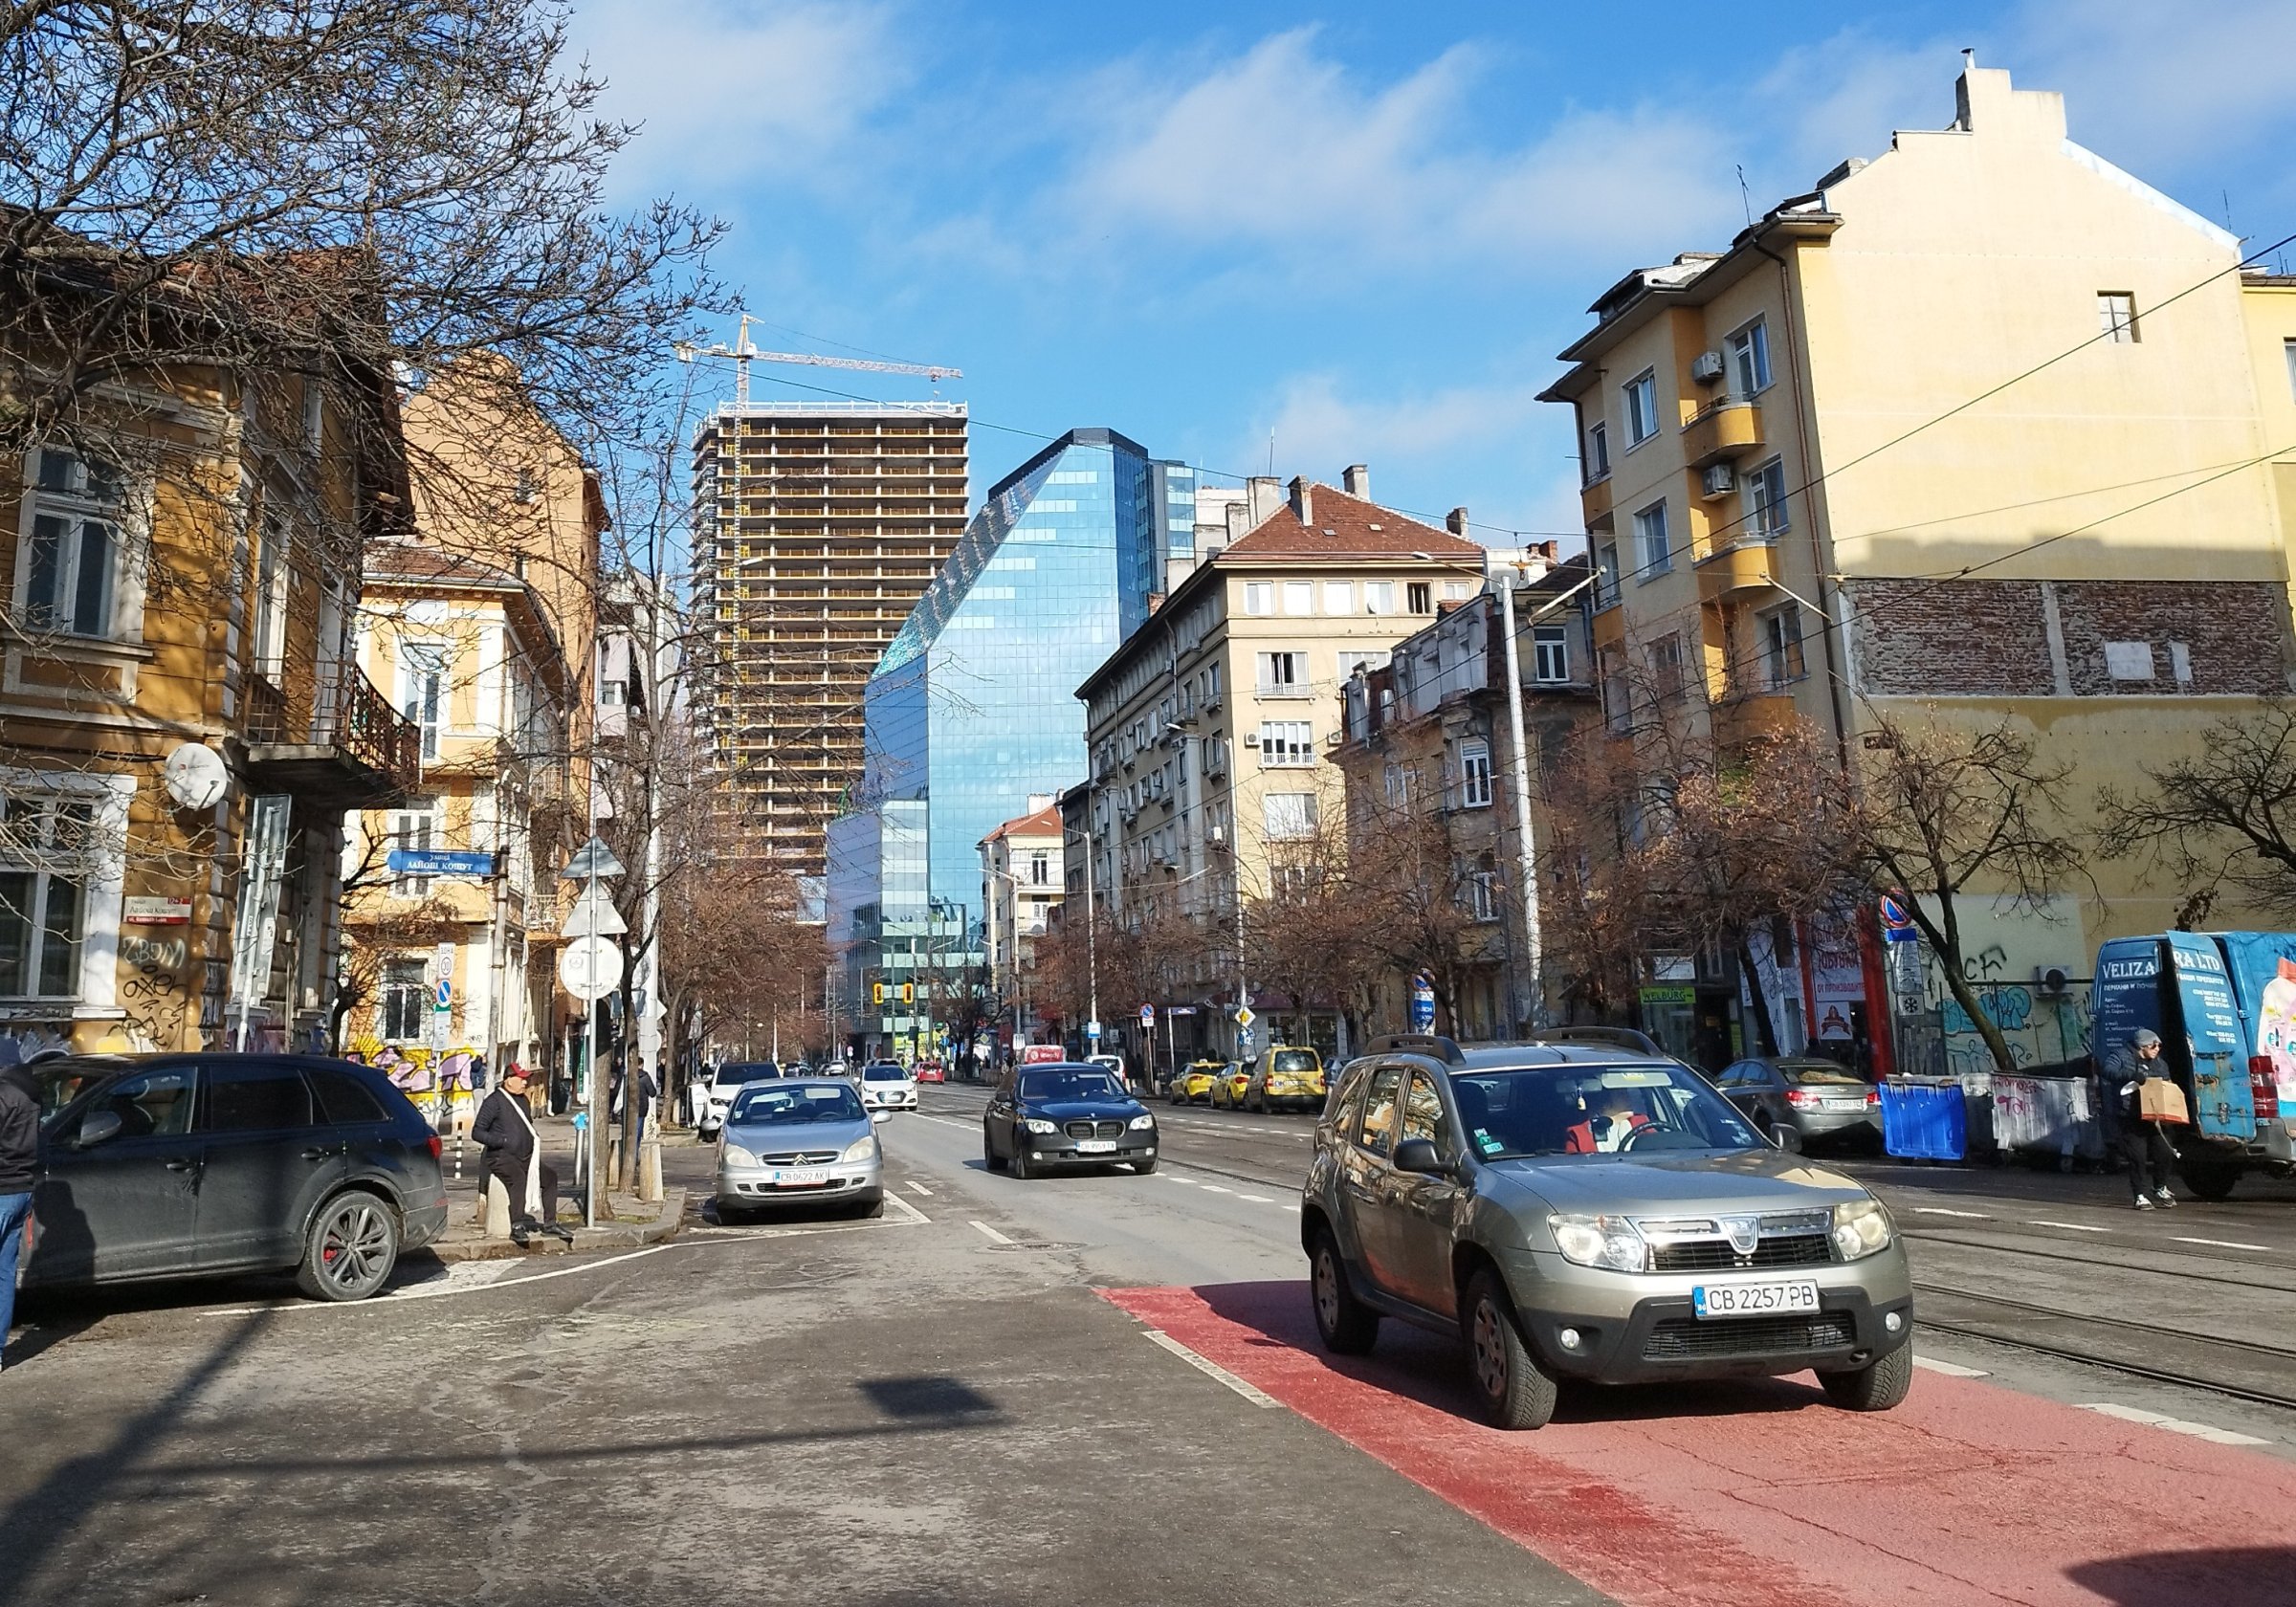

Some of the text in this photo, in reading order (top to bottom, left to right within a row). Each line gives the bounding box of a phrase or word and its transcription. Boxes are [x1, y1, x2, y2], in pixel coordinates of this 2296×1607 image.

[2103, 961, 2155, 979] VELIZA
[2196, 953, 2219, 970] LTD
[1710, 1286, 1815, 1310] CB 2257 PB
